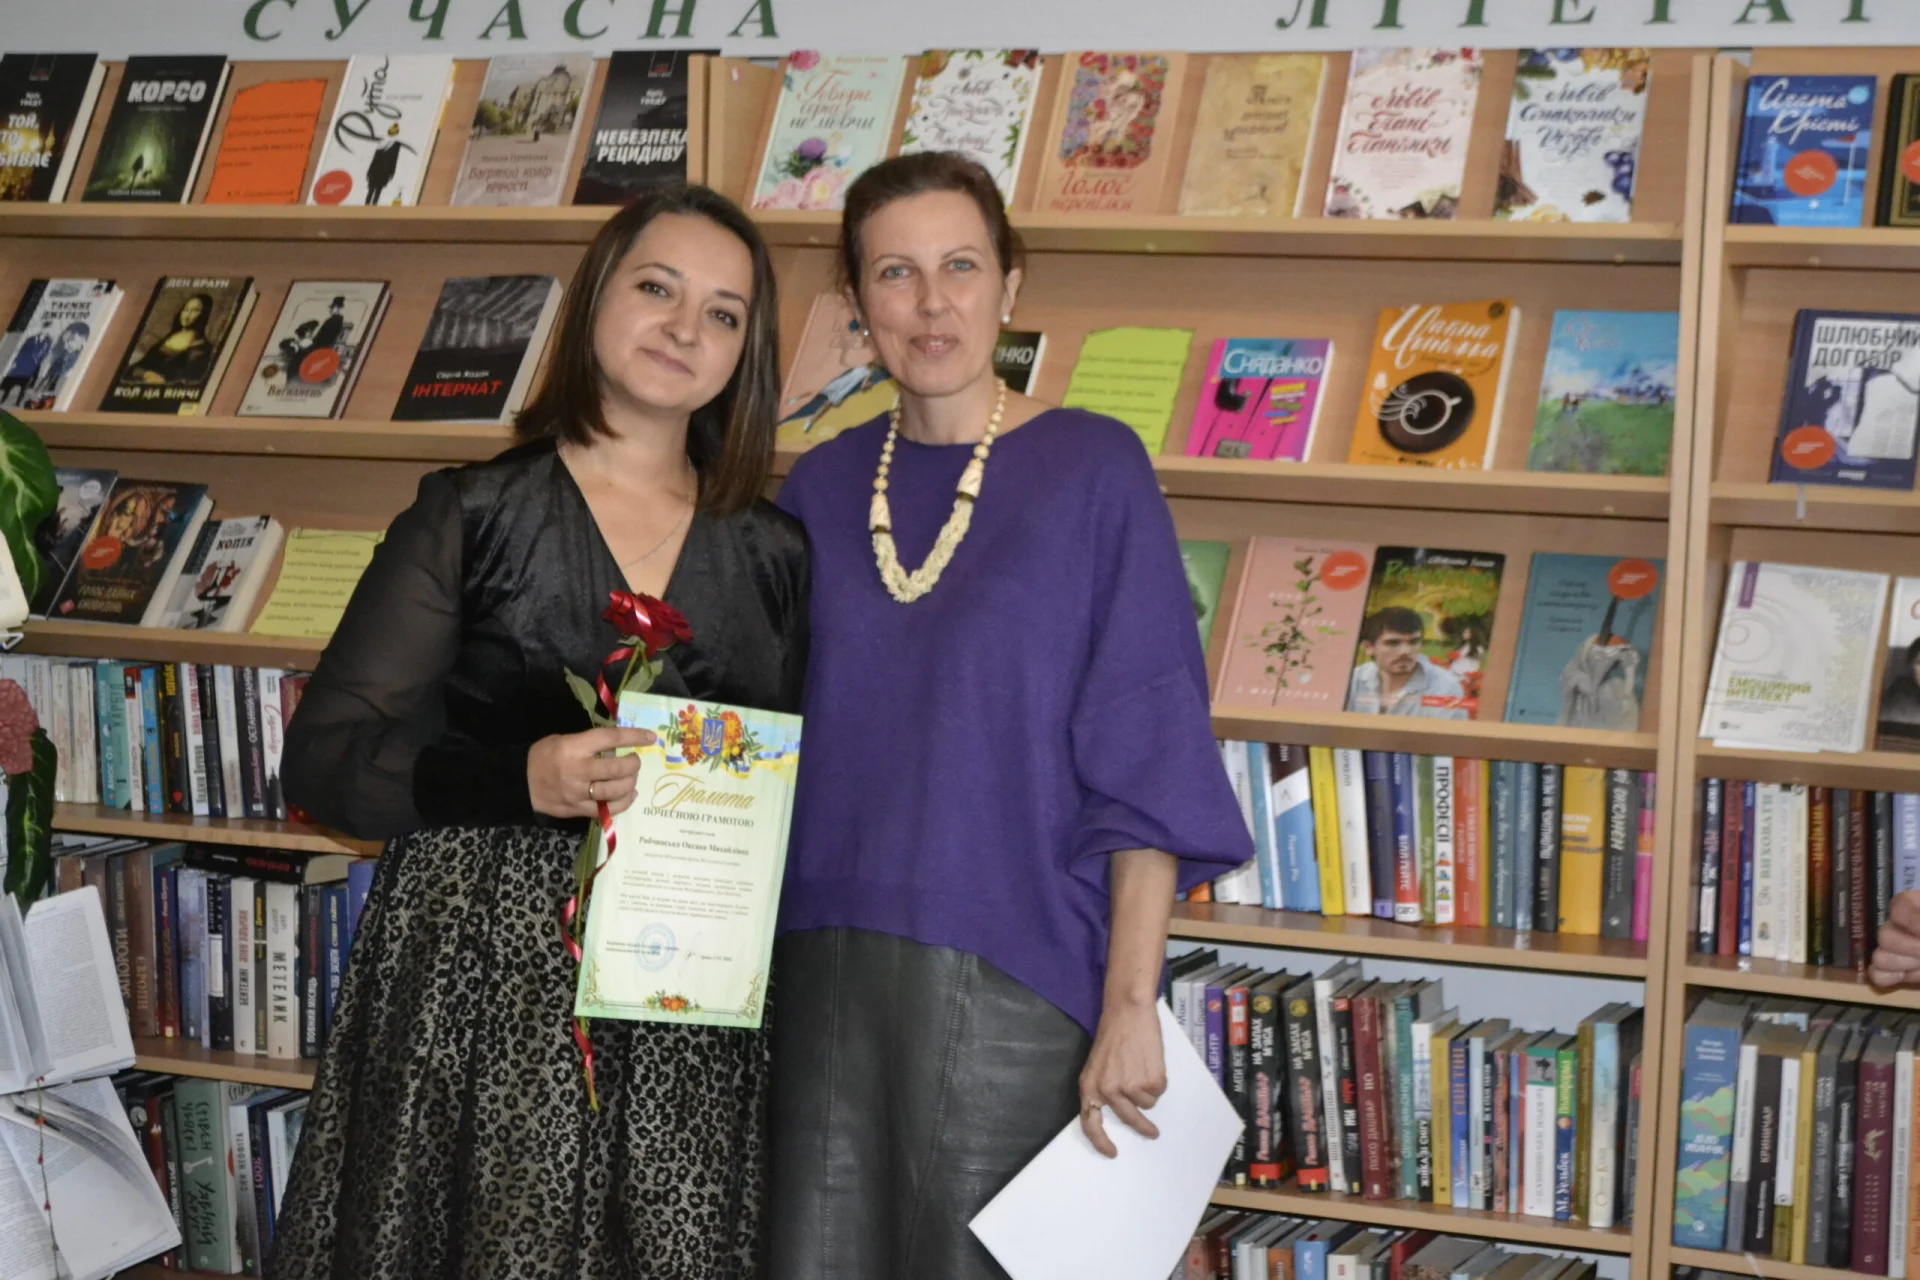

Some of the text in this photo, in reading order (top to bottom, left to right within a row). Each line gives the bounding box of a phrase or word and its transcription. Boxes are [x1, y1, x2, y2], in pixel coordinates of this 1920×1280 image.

[127, 81, 207, 103] КОРСО
[1758, 77, 1849, 111] Агата
[597, 146, 684, 164] РЕЦИДИВУ
[1811, 346, 1903, 370] ДОГОВІР
[412, 380, 502, 398] ІНТЕРНАТ
[651, 772, 755, 811] Грамота
[1436, 766, 1450, 843] ПРОФЕСІЇ
[643, 807, 754, 828] ПОЧЕСНОЮ ГРАМОТОЮ
[272, 951, 288, 1024] МЕТЕЛИК
[1252, 1018, 1264, 1050] ЗАПАХ
[1209, 1033, 1223, 1069] ЦЕНТР
[1366, 1099, 1378, 1140] ДАШВАР
